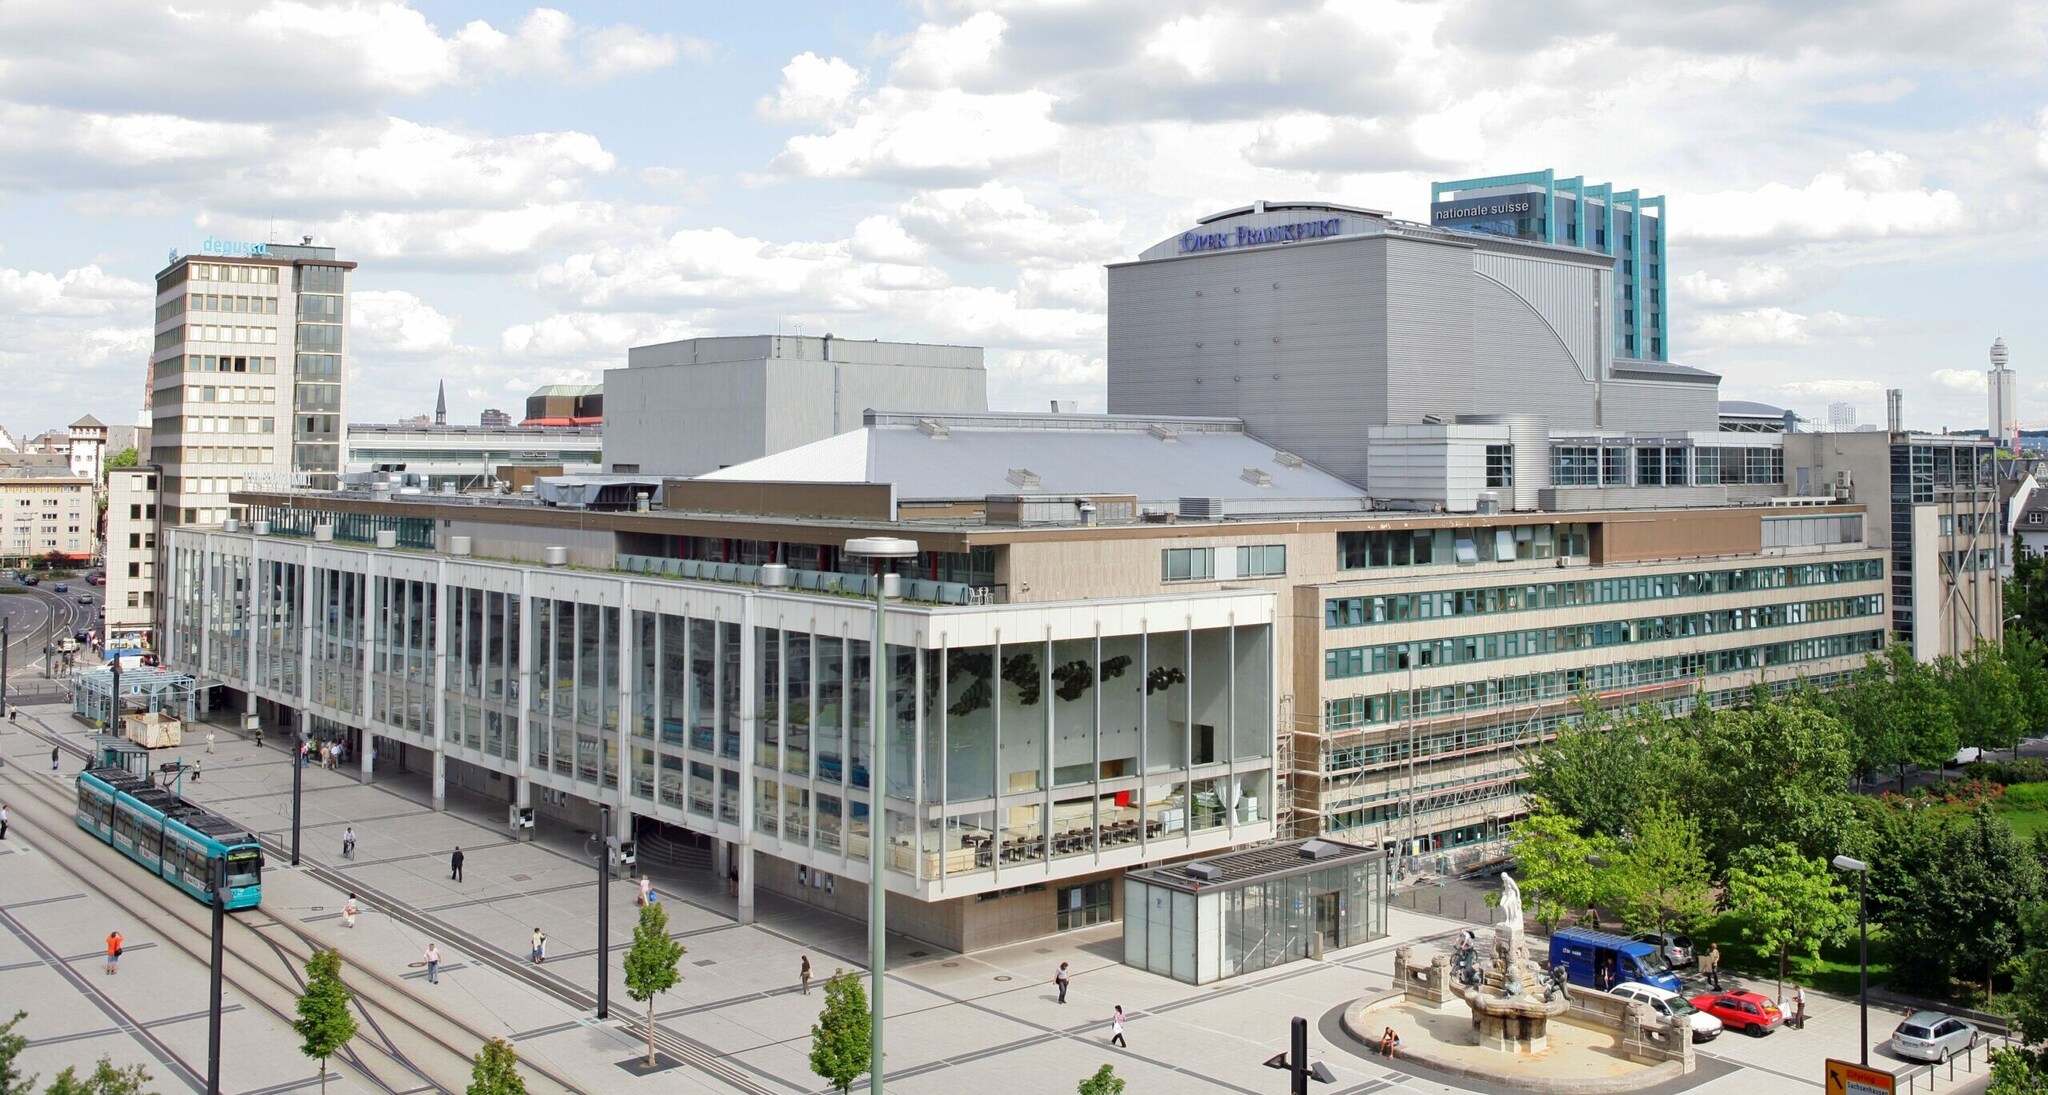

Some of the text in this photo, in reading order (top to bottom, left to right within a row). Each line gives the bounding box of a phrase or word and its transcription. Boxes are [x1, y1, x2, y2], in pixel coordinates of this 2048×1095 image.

[1436, 202, 1530, 220] nationale suisse
[203, 235, 268, 255] degussa
[1181, 218, 1341, 253] OPER FRANKFURT
[1847, 1069, 1876, 1084] Cityring
